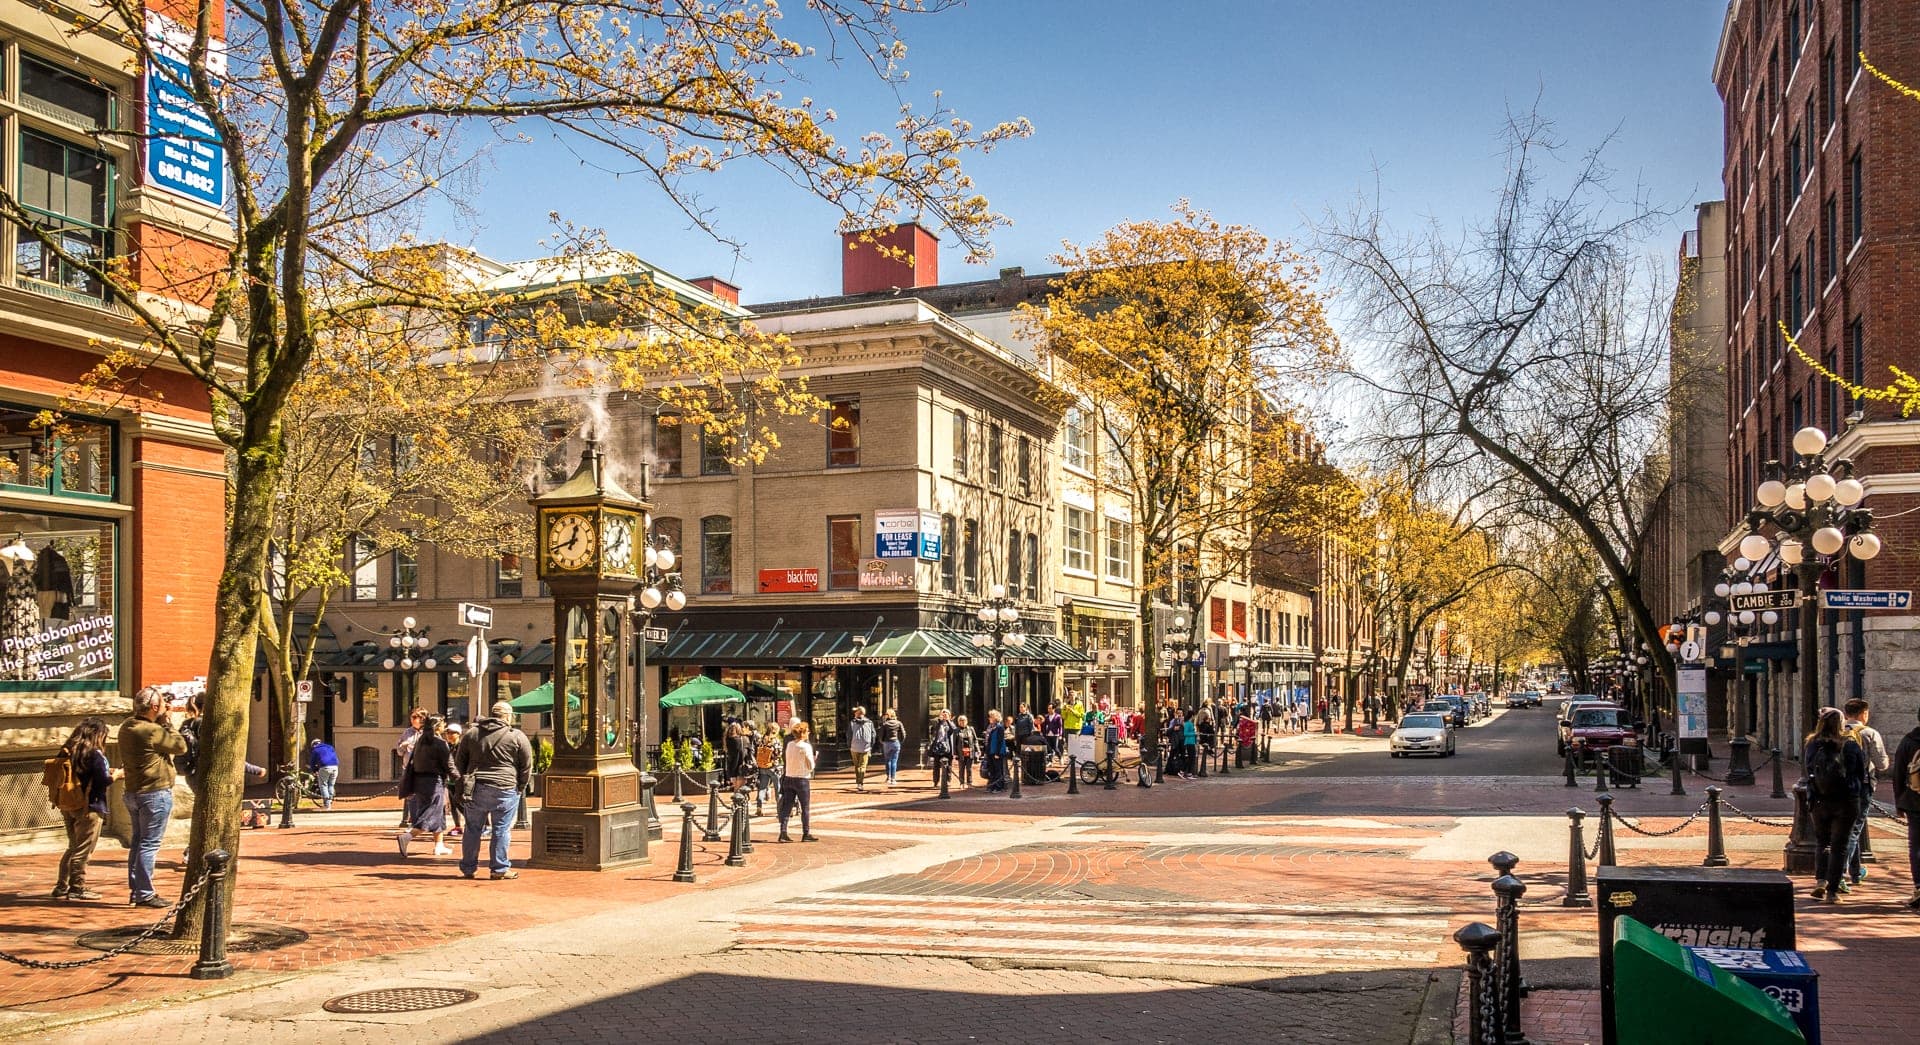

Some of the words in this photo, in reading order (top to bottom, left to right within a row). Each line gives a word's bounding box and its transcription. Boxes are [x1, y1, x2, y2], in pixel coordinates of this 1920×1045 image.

[881, 533, 894, 541] FOR
[894, 533, 913, 541] LEASE
[787, 570, 804, 584] black
[804, 569, 818, 586] frog
[860, 571, 914, 586] Michelle's
[1736, 594, 1775, 609] CAMBIE
[1829, 594, 1851, 602] Public
[1852, 594, 1888, 602] Washroom
[2, 614, 114, 654] Photobombing
[27, 643, 74, 665] steam
[77, 629, 114, 650] clock
[36, 660, 74, 681] since
[78, 646, 114, 668] 2018
[811, 657, 861, 665] STARBUCKS
[866, 657, 898, 665] COFFEE
